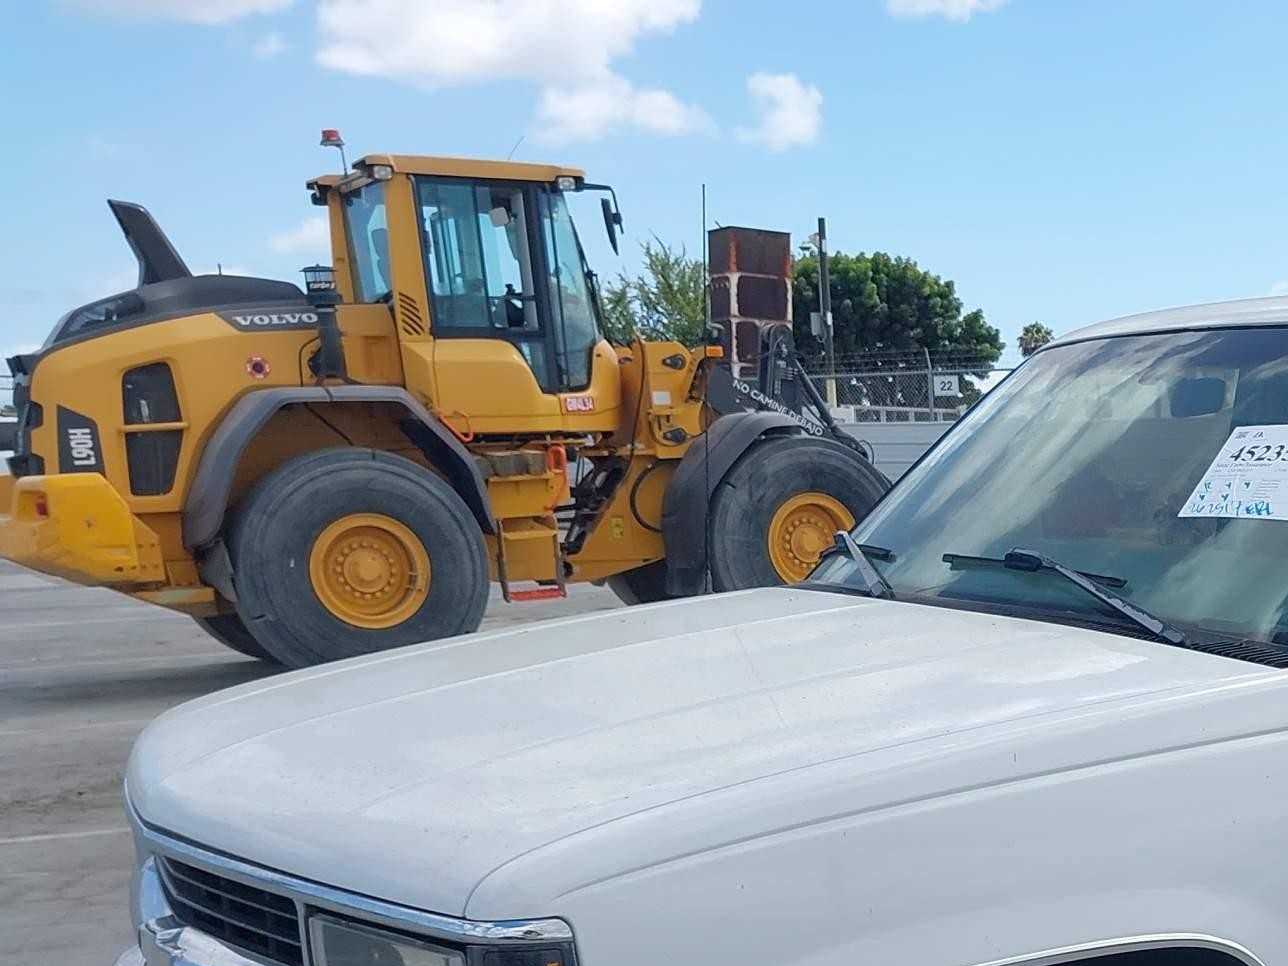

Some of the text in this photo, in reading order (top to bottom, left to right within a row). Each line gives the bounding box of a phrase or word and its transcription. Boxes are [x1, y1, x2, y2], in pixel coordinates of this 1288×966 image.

[232, 312, 318, 326] VOLVO
[732, 380, 750, 394] NO
[750, 389, 788, 416] CAMINE
[940, 381, 953, 391] 22
[67, 428, 96, 466] L90H
